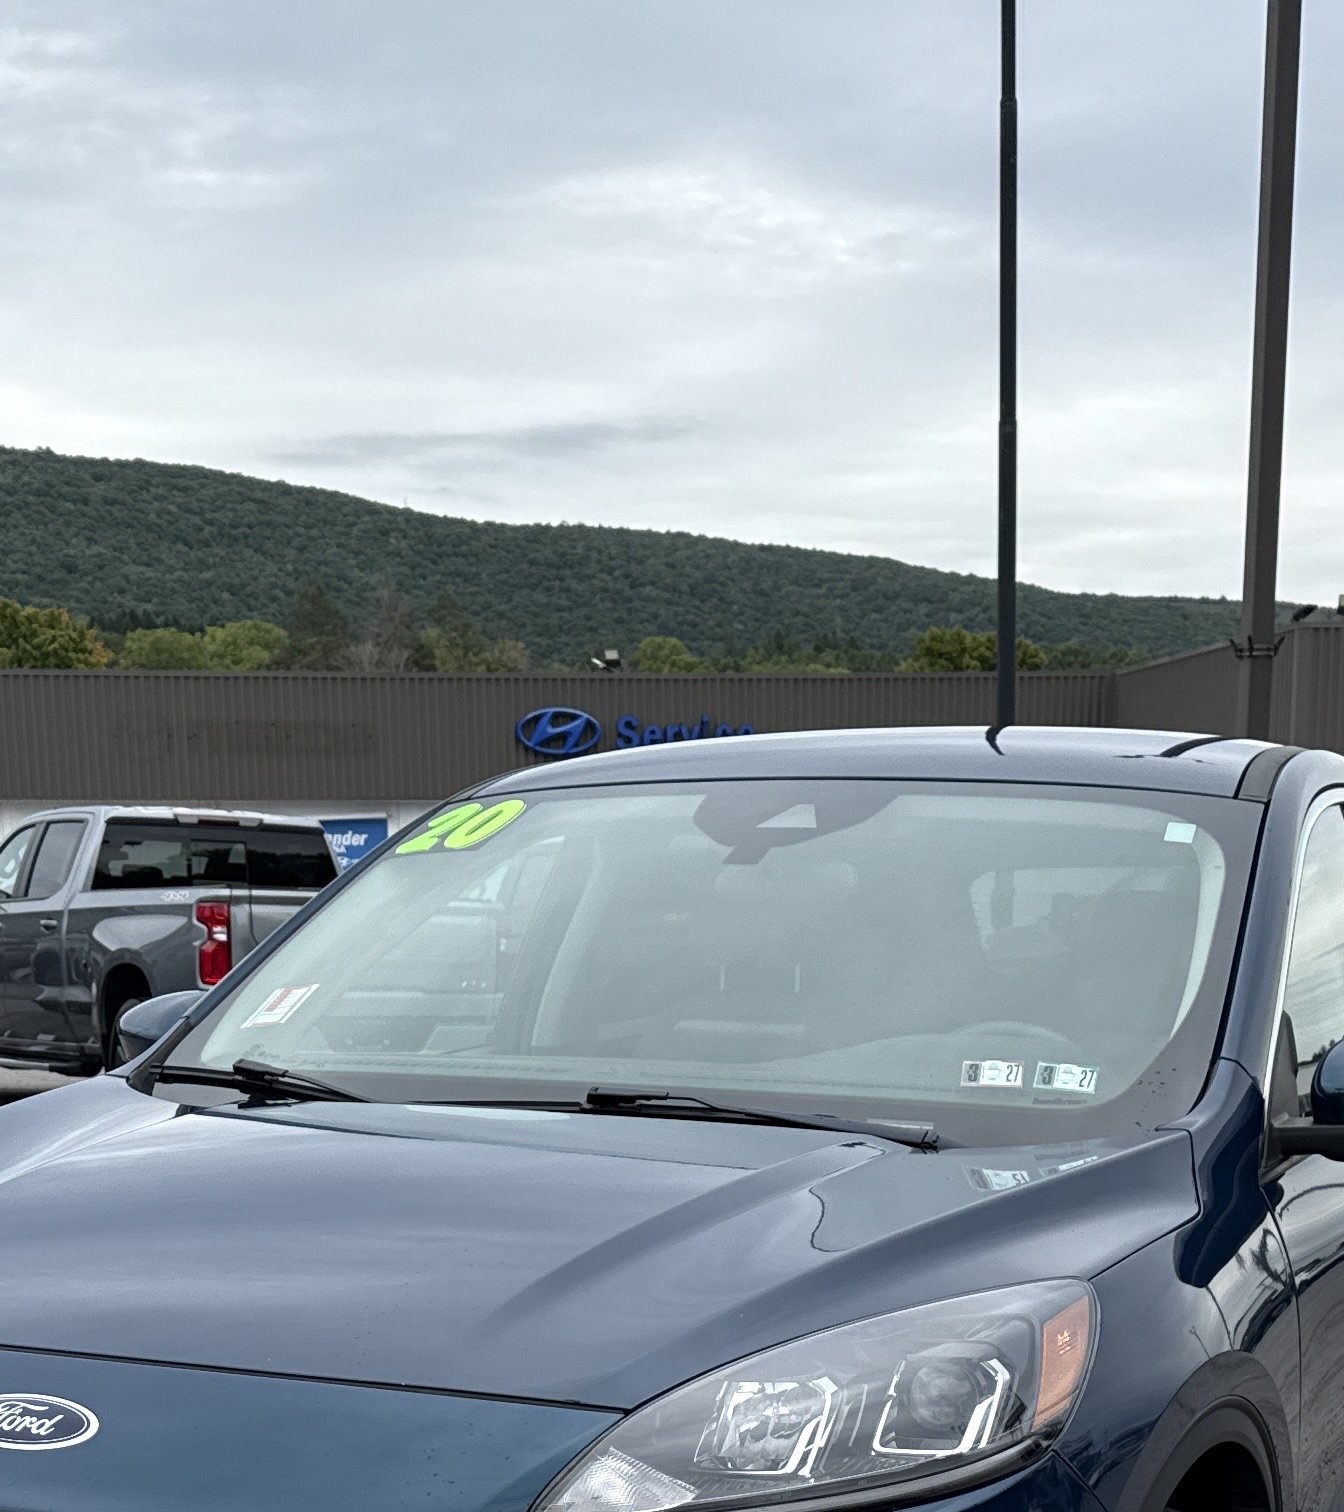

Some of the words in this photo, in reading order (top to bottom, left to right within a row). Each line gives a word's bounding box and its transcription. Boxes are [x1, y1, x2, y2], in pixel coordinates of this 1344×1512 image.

[394, 799, 527, 854] 20
[967, 1064, 979, 1082] 3
[1006, 1065, 1020, 1082] 27
[1042, 1066, 1054, 1085] 3
[1079, 1070, 1095, 1088] 27
